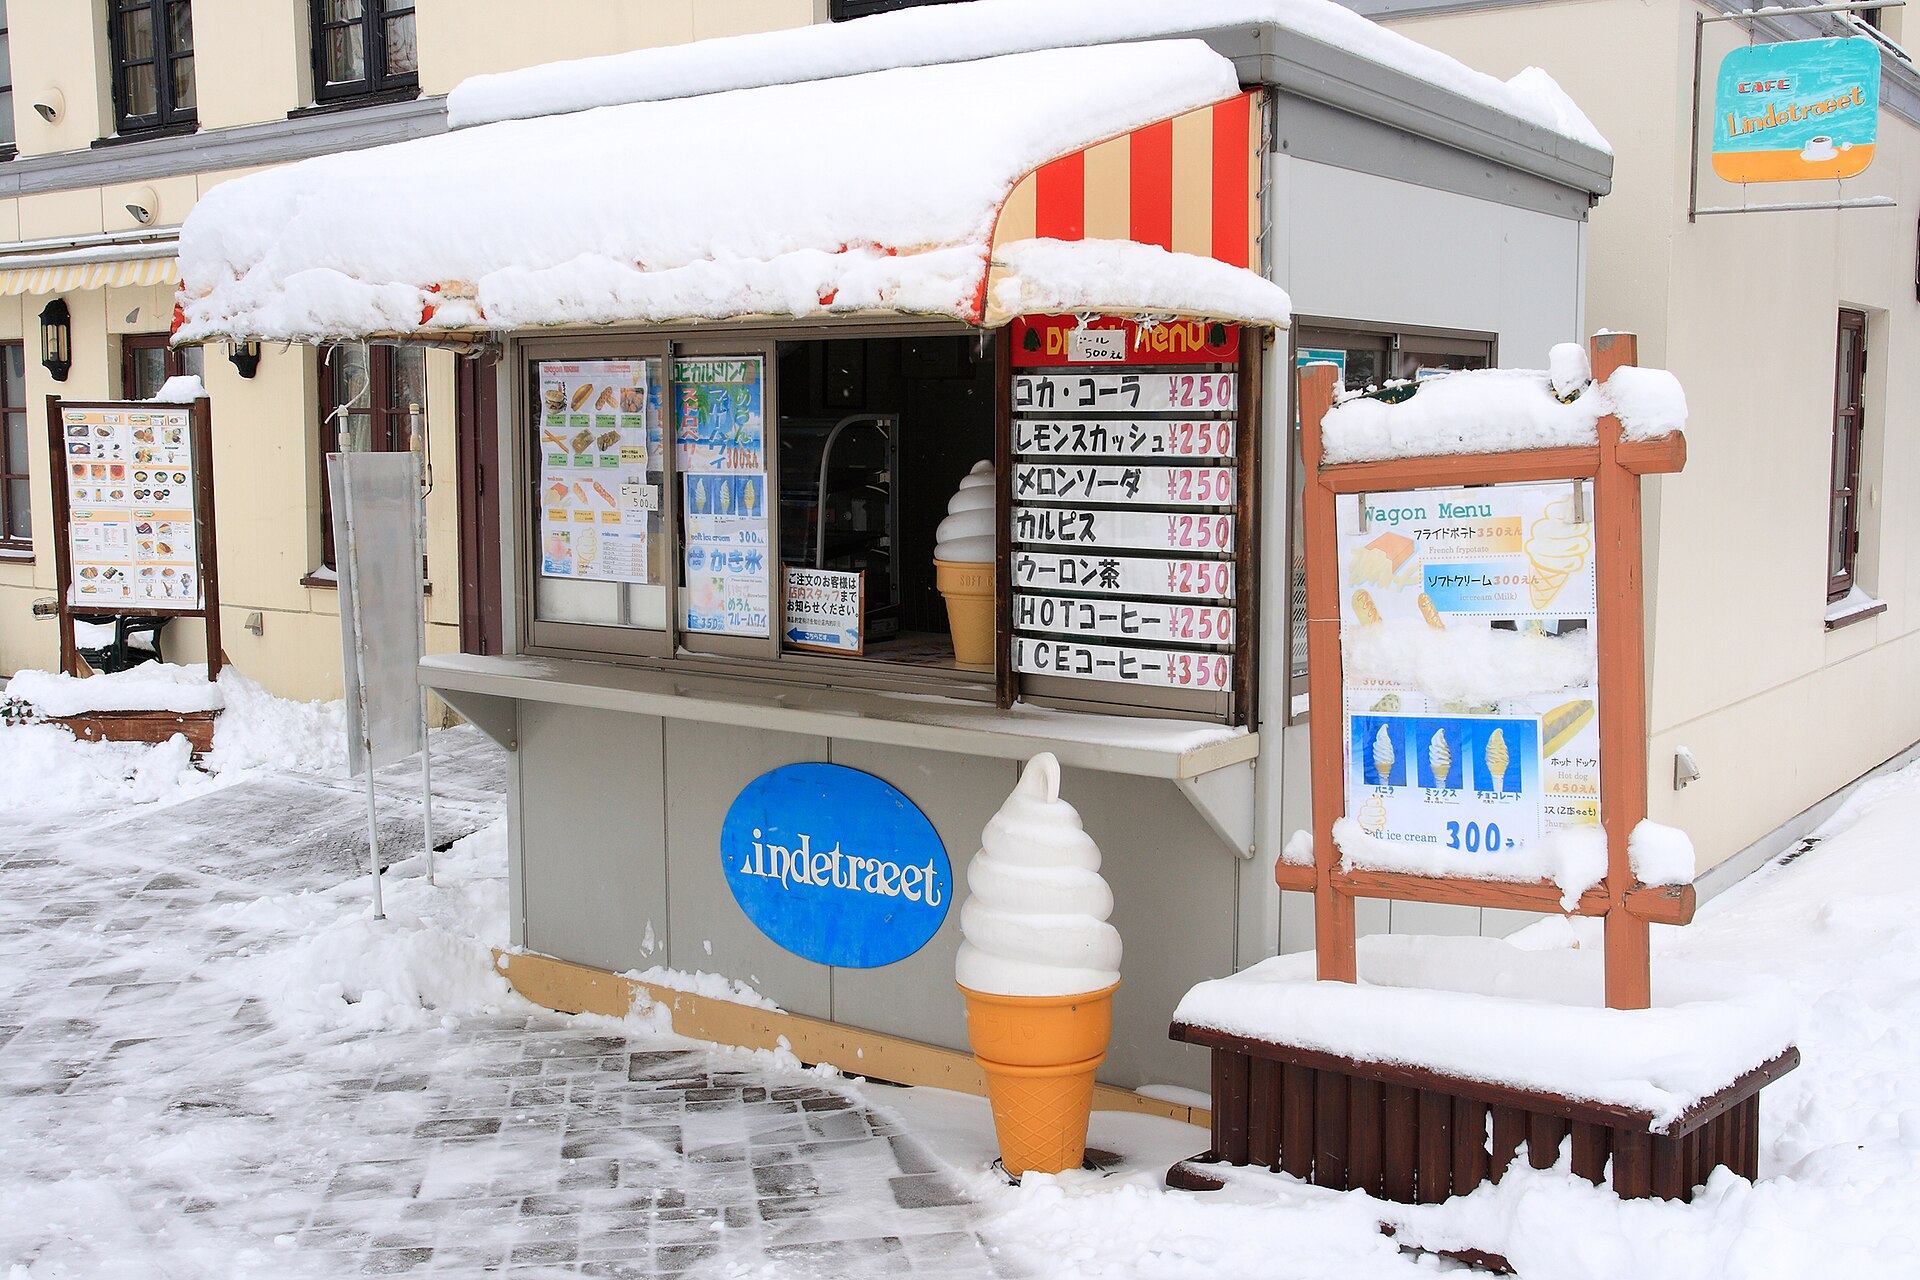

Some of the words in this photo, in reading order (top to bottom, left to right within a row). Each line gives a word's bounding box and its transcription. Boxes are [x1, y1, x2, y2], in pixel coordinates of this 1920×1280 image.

[1738, 78, 1791, 94] CAFE
[1017, 376, 1141, 408] コカ・コーラ
[1168, 375, 1231, 407] ¥250
[1017, 423, 1165, 453] レモンスカッシュ
[1168, 423, 1231, 455] ¥250
[1018, 466, 1142, 499] メロンソーダ
[1167, 469, 1230, 502] ¥250
[1439, 503, 1492, 518] Menu
[1017, 510, 1097, 543] カルピス
[1167, 515, 1230, 548] ¥250
[1414, 527, 1476, 540] フライドポテト
[1477, 527, 1522, 538] 350えん
[1456, 546, 1489, 555] frypotato
[710, 548, 763, 575] かき氷
[789, 573, 857, 589] ご注文のお客様は
[1017, 555, 1120, 590] ウーロン茶
[1167, 562, 1229, 595] ¥250
[1428, 575, 1492, 587] ソフトクリーム
[1494, 575, 1539, 585] 300えん
[789, 587, 857, 603] 店内スタッフまで
[787, 600, 859, 617] お知らせください。
[1019, 597, 1161, 633] HOTコーヒー
[1169, 607, 1231, 640] ¥250
[1018, 640, 1161, 679] ICEコーヒー
[1166, 653, 1228, 687] ¥350
[1551, 757, 1571, 767] ホット
[1558, 771, 1572, 779] Hot
[1574, 772, 1588, 781] dog
[1375, 786, 1394, 794] バニラ
[1426, 788, 1457, 797] ミックス
[1477, 792, 1521, 801] チョコレート
[1553, 783, 1596, 794] 450えん
[1387, 830, 1402, 840] ice
[1404, 833, 1438, 843] cream
